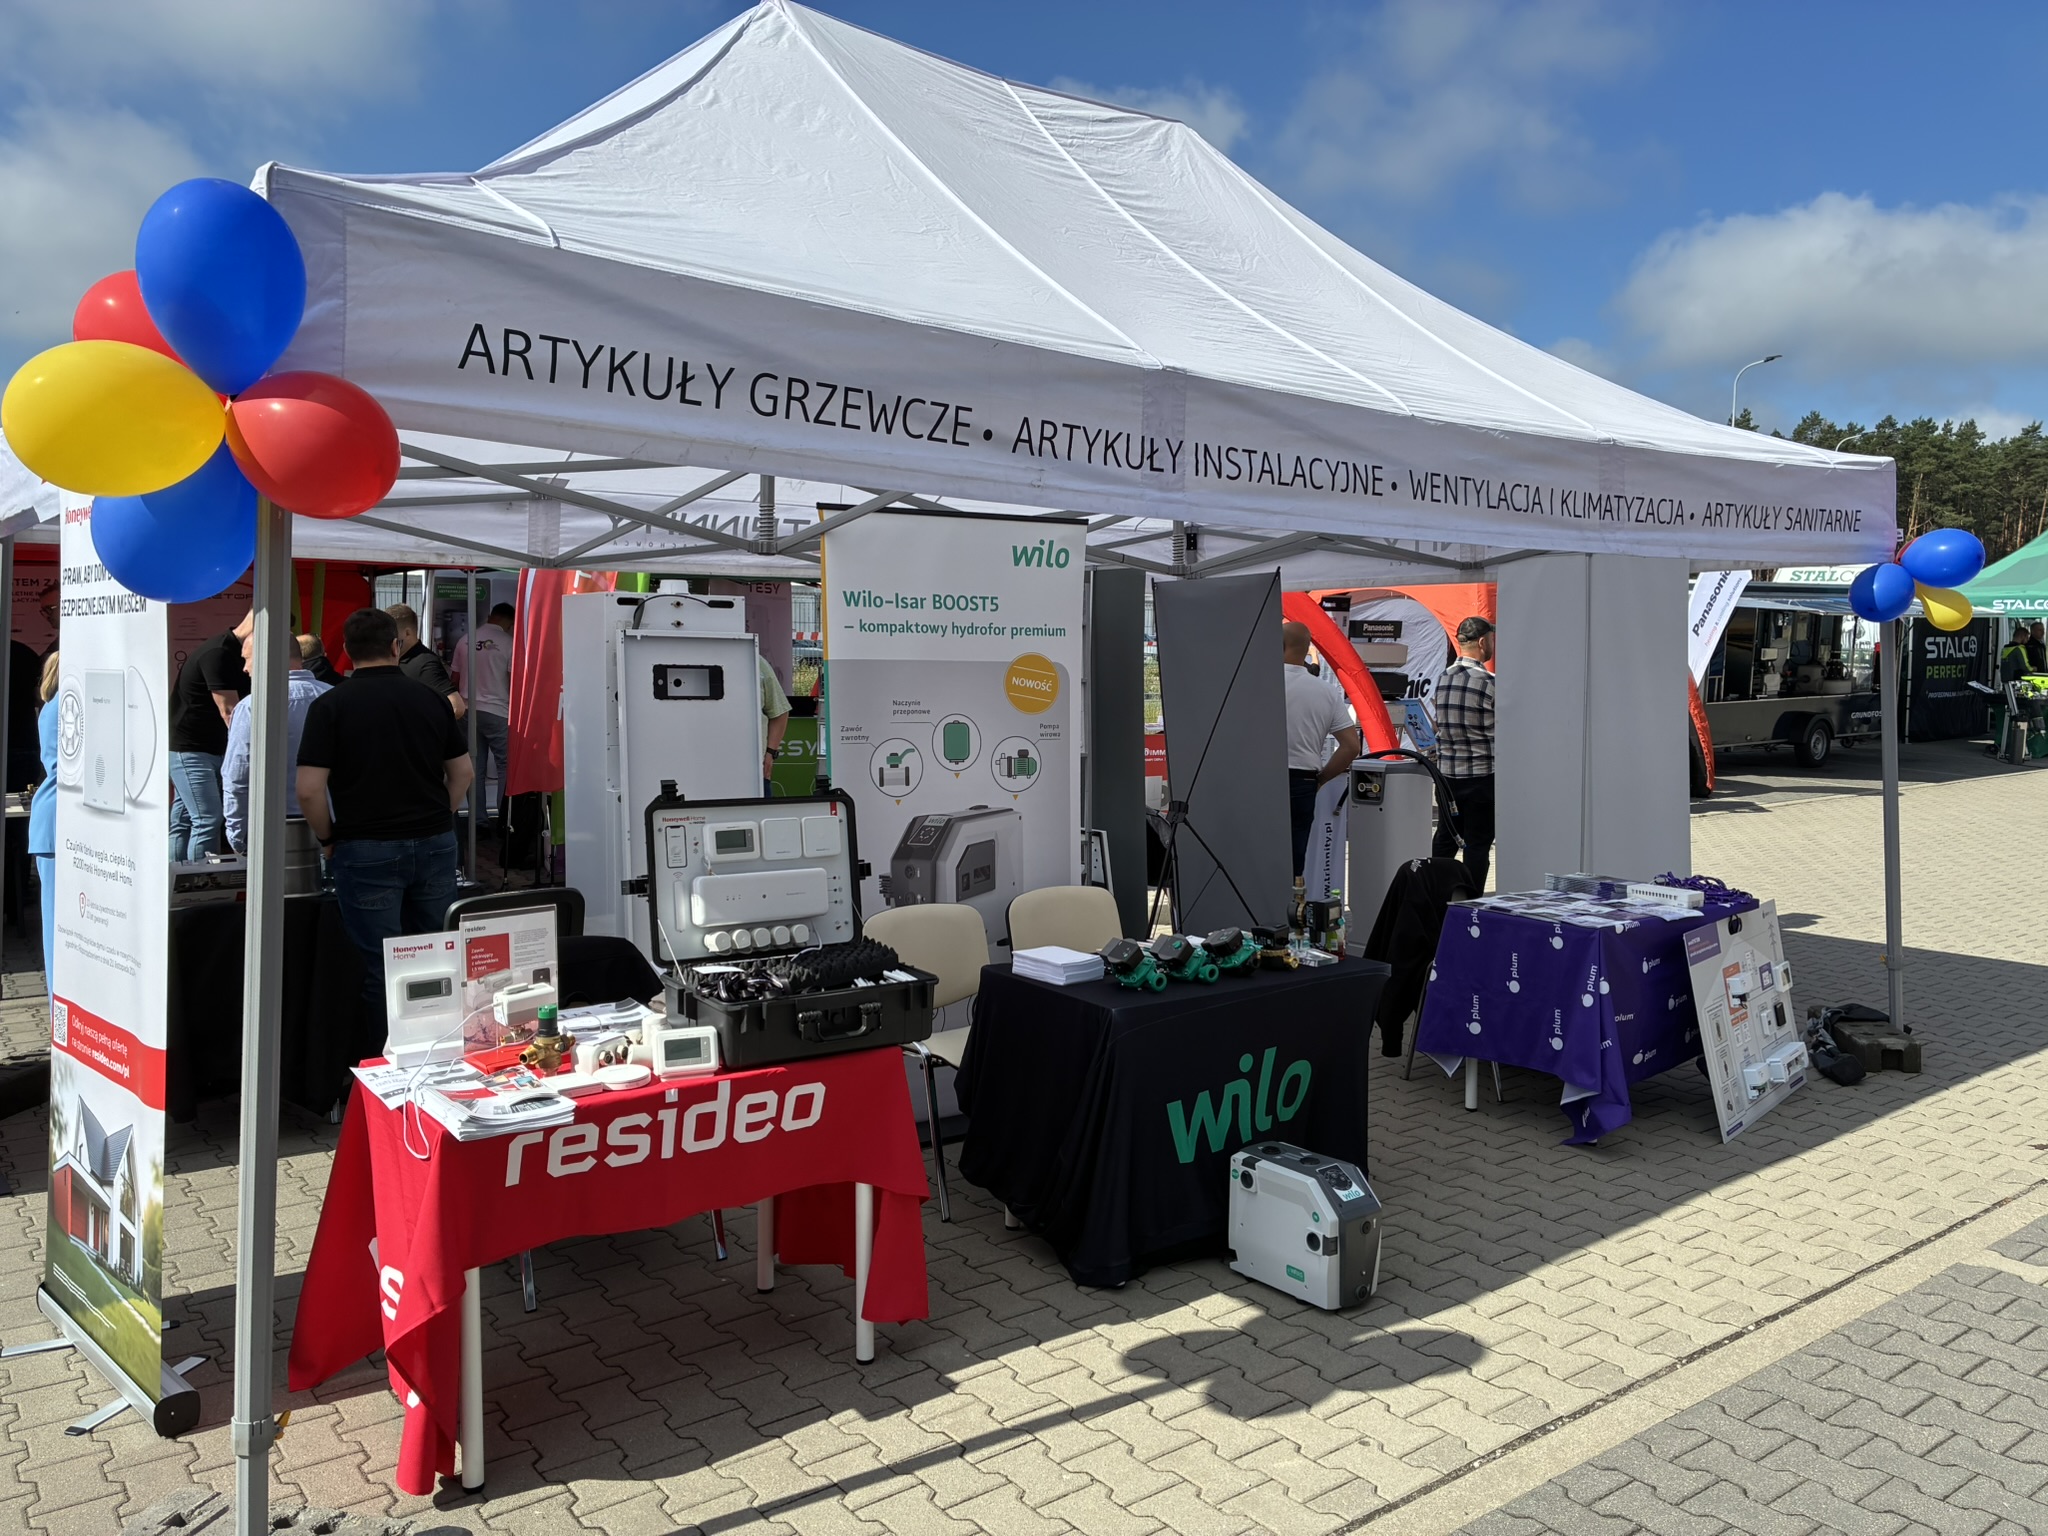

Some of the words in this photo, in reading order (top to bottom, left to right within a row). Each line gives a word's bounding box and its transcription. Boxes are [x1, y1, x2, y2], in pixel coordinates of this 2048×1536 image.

[457, 323, 735, 410] ARTYKUŁY
[749, 371, 973, 447] GRZEWCZE
[1012, 417, 1184, 475] ARTYKUŁY
[1194, 442, 1384, 497] INSTALACYJNE
[1408, 470, 1542, 515] WENTYLACJA
[1549, 488, 1554, 515] I
[1561, 489, 1684, 526] KLIMATYZACJA
[1702, 501, 1784, 531] ARTYKUŁY
[1784, 506, 1862, 533] SANITARNE
[1012, 539, 1070, 568] wilo
[843, 590, 927, 610] Wilo-Isar
[932, 594, 999, 612] BOOST5
[1692, 571, 1732, 637] Panasonic
[859, 619, 947, 638] kompaktowy
[951, 621, 1007, 638] hydrofor
[1010, 623, 1066, 639] premium
[1363, 623, 1394, 631] Panasonic
[1926, 665, 1967, 679] PERFECT
[1012, 676, 1053, 692] NOWOŚĆ
[892, 700, 921, 708] Naczynie
[892, 708, 931, 716] przeponowe
[841, 724, 863, 733] Zawór
[841, 734, 870, 742] zwrotny
[1039, 723, 1060, 731] Pompa
[393, 943, 433, 955] Honeywell
[393, 952, 416, 961] Home
[1510, 952, 1519, 978] plum
[1587, 965, 1597, 992] plum
[1471, 994, 1481, 1020] plum
[1553, 1009, 1563, 1035] plum
[1166, 1046, 1313, 1164] wilo
[506, 1080, 826, 1187] resideo
[1342, 1190, 1361, 1200] wilo
